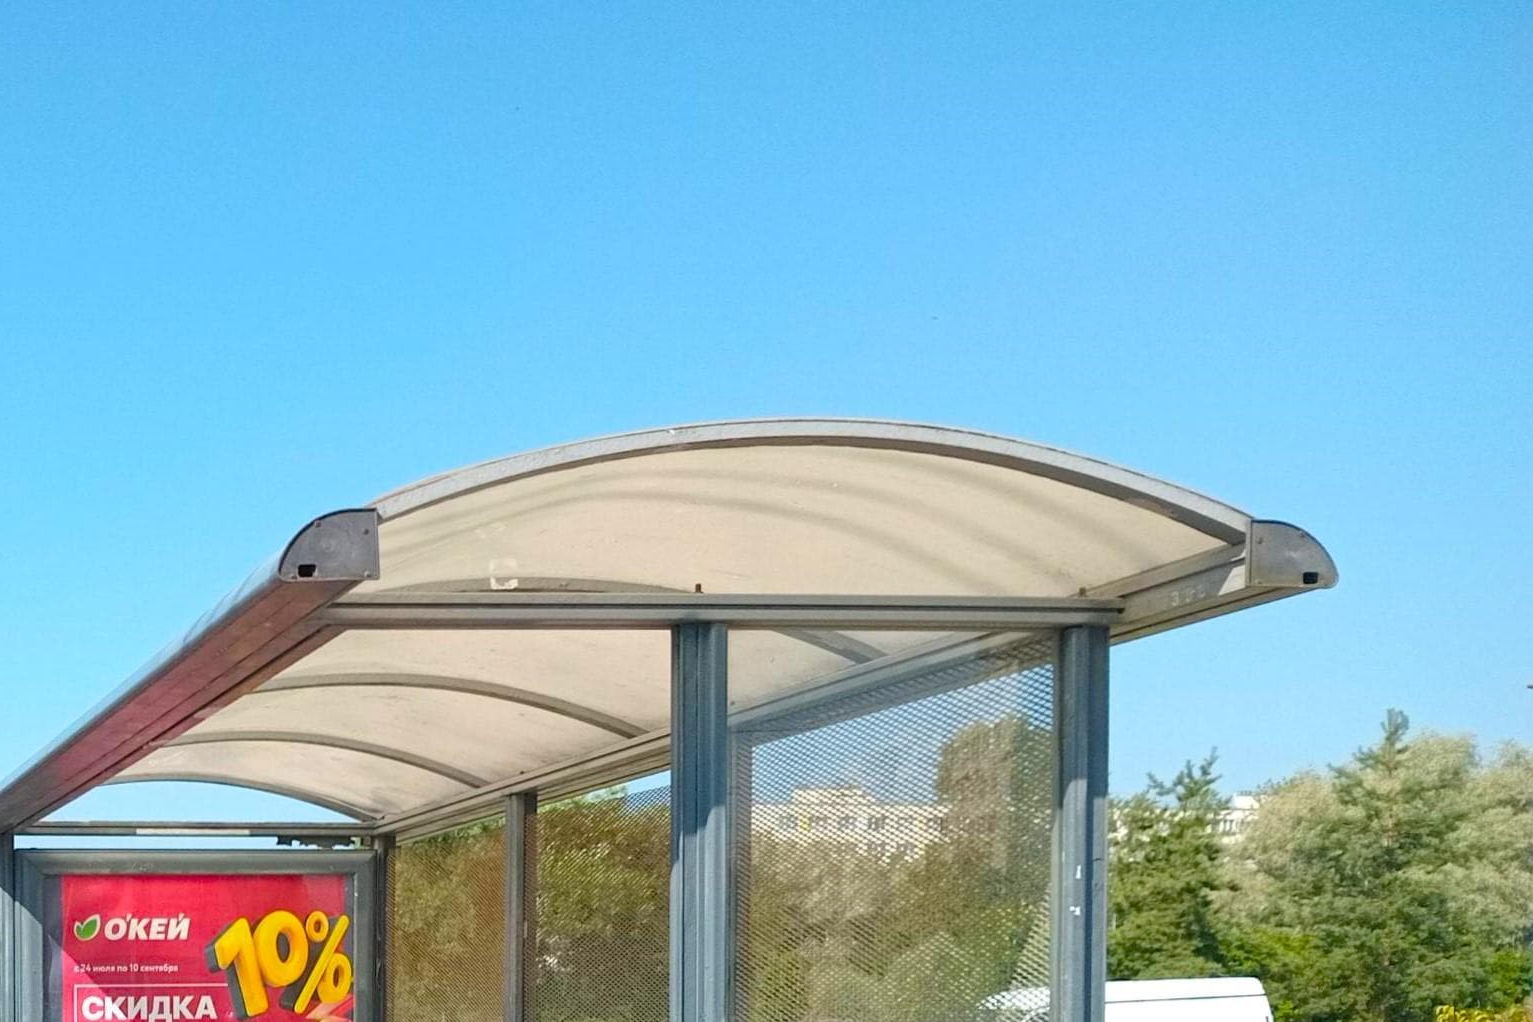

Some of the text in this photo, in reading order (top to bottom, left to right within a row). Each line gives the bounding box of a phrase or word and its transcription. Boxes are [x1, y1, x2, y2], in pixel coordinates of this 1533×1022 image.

[80, 963, 91, 973] 24
[92, 965, 116, 973] июля
[117, 965, 128, 973] по
[128, 962, 139, 972] 10
[139, 963, 179, 974] сентября
[207, 908, 353, 1021] 10%
